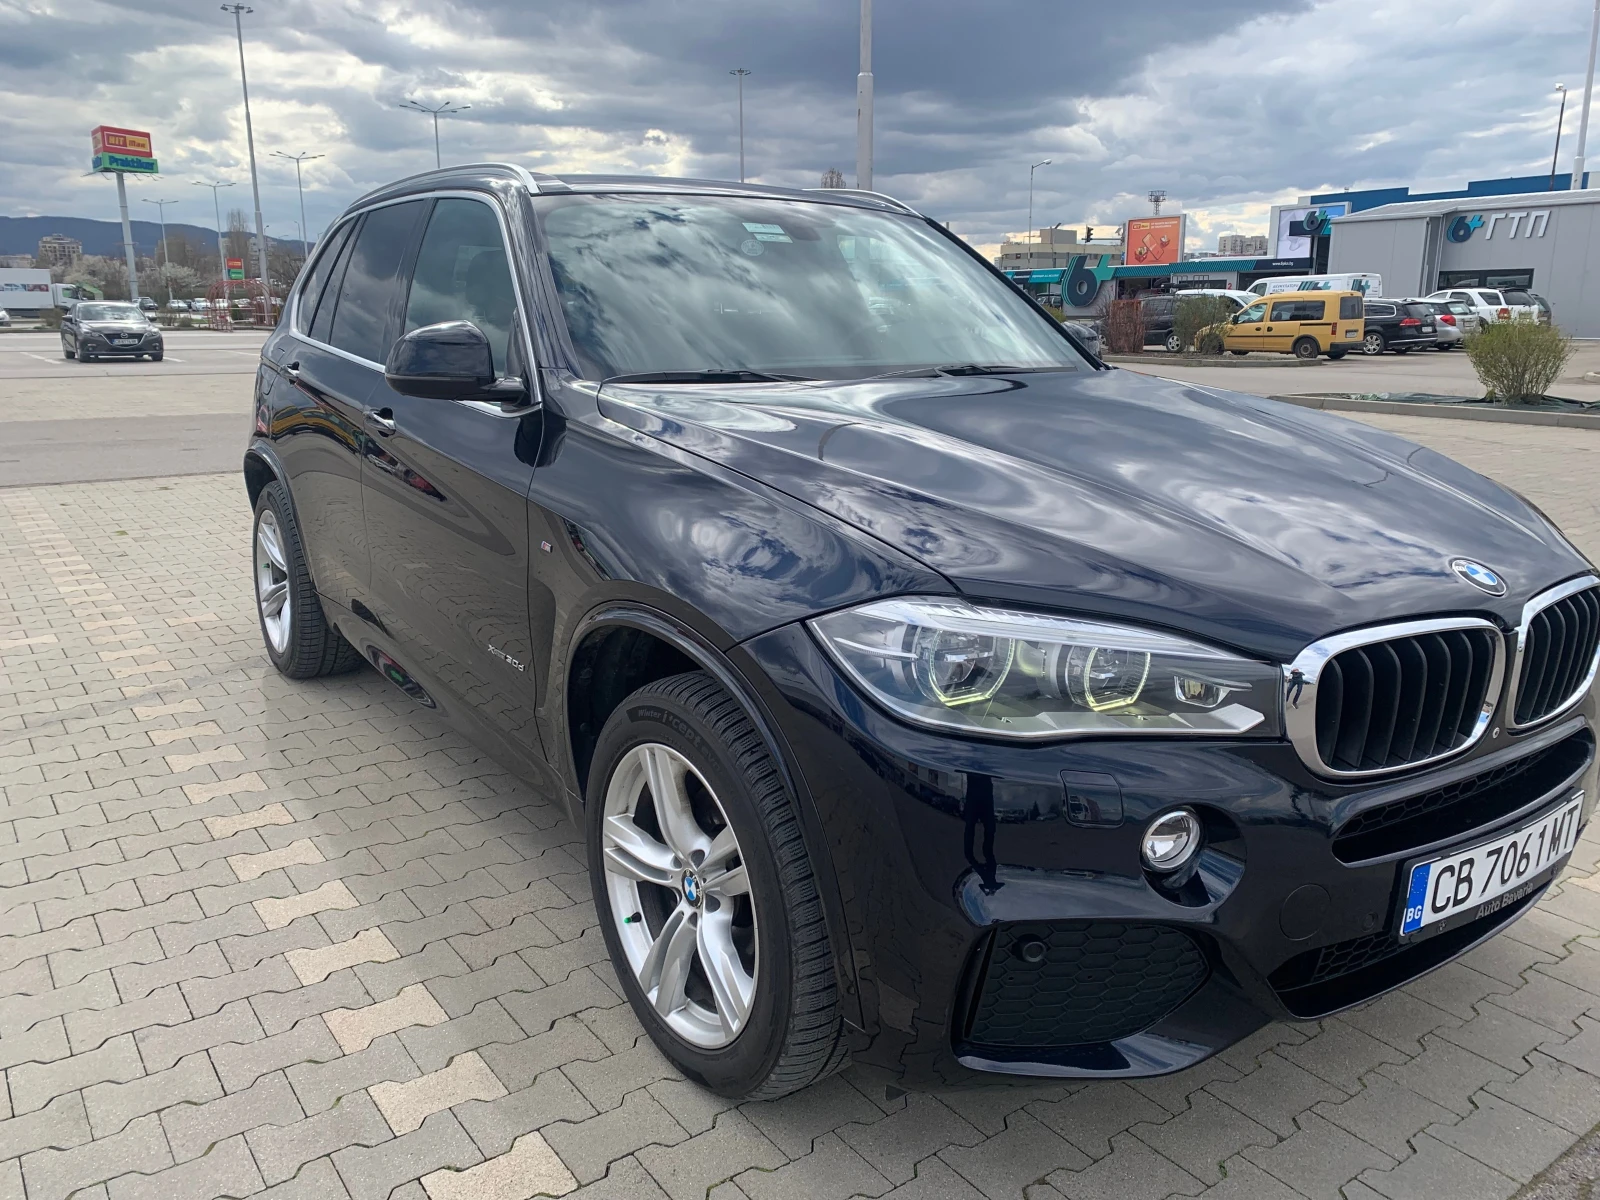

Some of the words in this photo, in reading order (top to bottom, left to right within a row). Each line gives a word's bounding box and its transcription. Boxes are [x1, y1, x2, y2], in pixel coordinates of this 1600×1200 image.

[1485, 210, 1552, 240] ГТП
[638, 708, 662, 719] Winter
[1431, 857, 1475, 914] CB
[1479, 824, 1548, 898] 7061
[1405, 905, 1422, 923] BG
[1475, 901, 1500, 920] Auto
